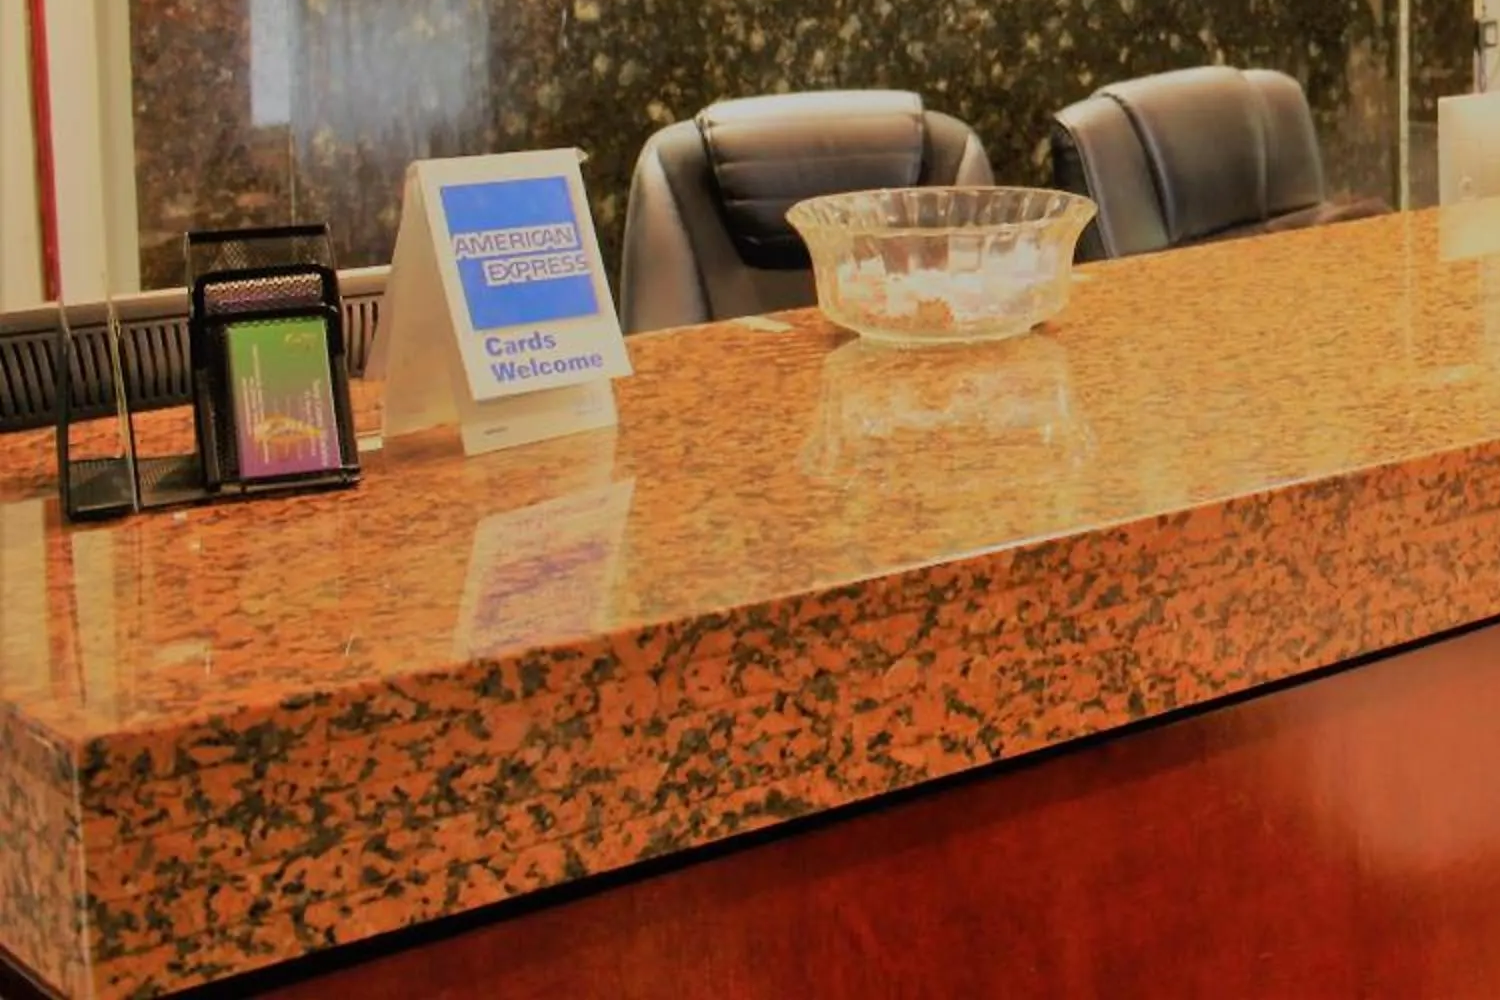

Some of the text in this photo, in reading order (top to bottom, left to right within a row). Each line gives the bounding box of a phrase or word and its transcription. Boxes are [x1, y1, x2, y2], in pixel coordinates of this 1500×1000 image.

[454, 226, 574, 257] AMERICAN
[487, 254, 588, 281] EXPRESS
[485, 331, 557, 356] Cards
[490, 353, 603, 383] Welcome
